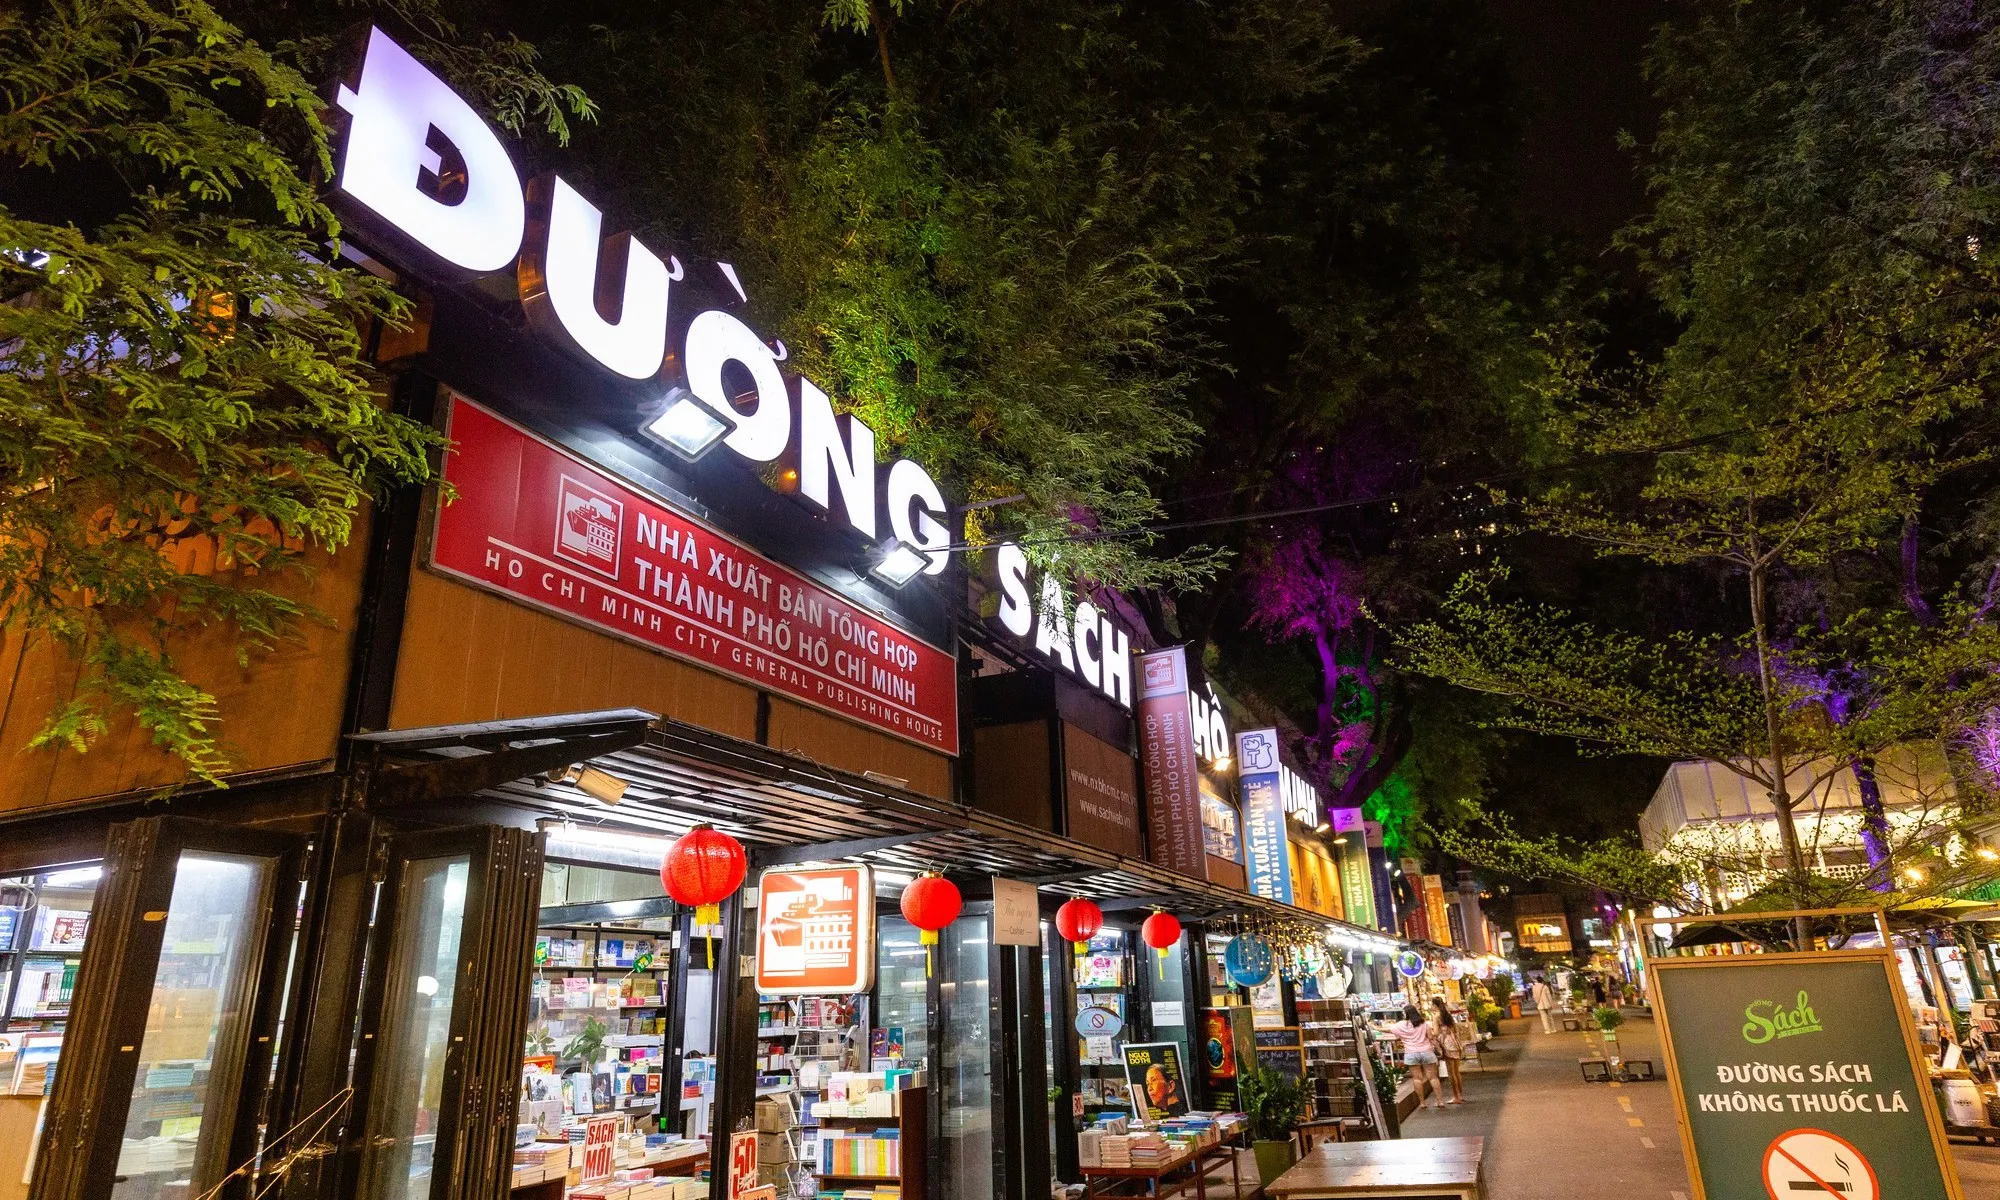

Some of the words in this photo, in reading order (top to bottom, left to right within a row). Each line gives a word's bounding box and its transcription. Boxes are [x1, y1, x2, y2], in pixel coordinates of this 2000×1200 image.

[336, 24, 950, 577] ĐƯỜNG
[998, 541, 1131, 711] SÁCH
[636, 511, 700, 571] NHÀ
[706, 547, 773, 603] XUẤT
[778, 583, 823, 629] BẢN
[828, 607, 880, 655] TỔNG
[884, 637, 918, 673] HỢP
[485, 548, 524, 579] HO
[541, 572, 586, 603] CHI
[601, 595, 662, 632] MINH
[675, 625, 720, 655] CITY
[732, 647, 808, 690] GENERAL
[817, 680, 900, 725] PUBLISHING
[906, 722, 943, 742] HOUSE
[633, 556, 734, 629] THÀNH
[742, 606, 792, 651] PHỐ
[798, 632, 830, 668] HỒ
[834, 649, 867, 685] CHÍ
[871, 665, 916, 706] MINH
[1162, 712, 1176, 745] MINH
[1177, 710, 1185, 733] HOUSE
[1163, 747, 1177, 769] CHÍ
[1180, 735, 1190, 774] PUBLISHING
[1148, 780, 1164, 805] BẢN
[1182, 775, 1193, 806] GENERAL
[1243, 781, 1263, 807] TRẺ
[1263, 779, 1274, 811] HOUSE
[1165, 793, 1183, 821] PHỐ
[1186, 806, 1194, 822] CITY
[1246, 808, 1268, 837] BẢN
[1150, 809, 1168, 841] XUẤT
[1171, 823, 1187, 870] THÀNH
[1248, 838, 1271, 874] XUẤT
[1267, 820, 1282, 881] PUBLISHING
[1349, 861, 1361, 884] NAM
[1742, 990, 1821, 1044] Sách
[1716, 1061, 1804, 1083] ĐƯỜNG
[1809, 1060, 1873, 1083] SÁCH
[1698, 1090, 1783, 1113] KHÔNG
[1786, 1088, 1873, 1113] THUỐC
[1876, 1089, 1910, 1113] LÁ
[587, 1120, 615, 1146] SÁCH
[583, 1143, 612, 1179] MỚI
